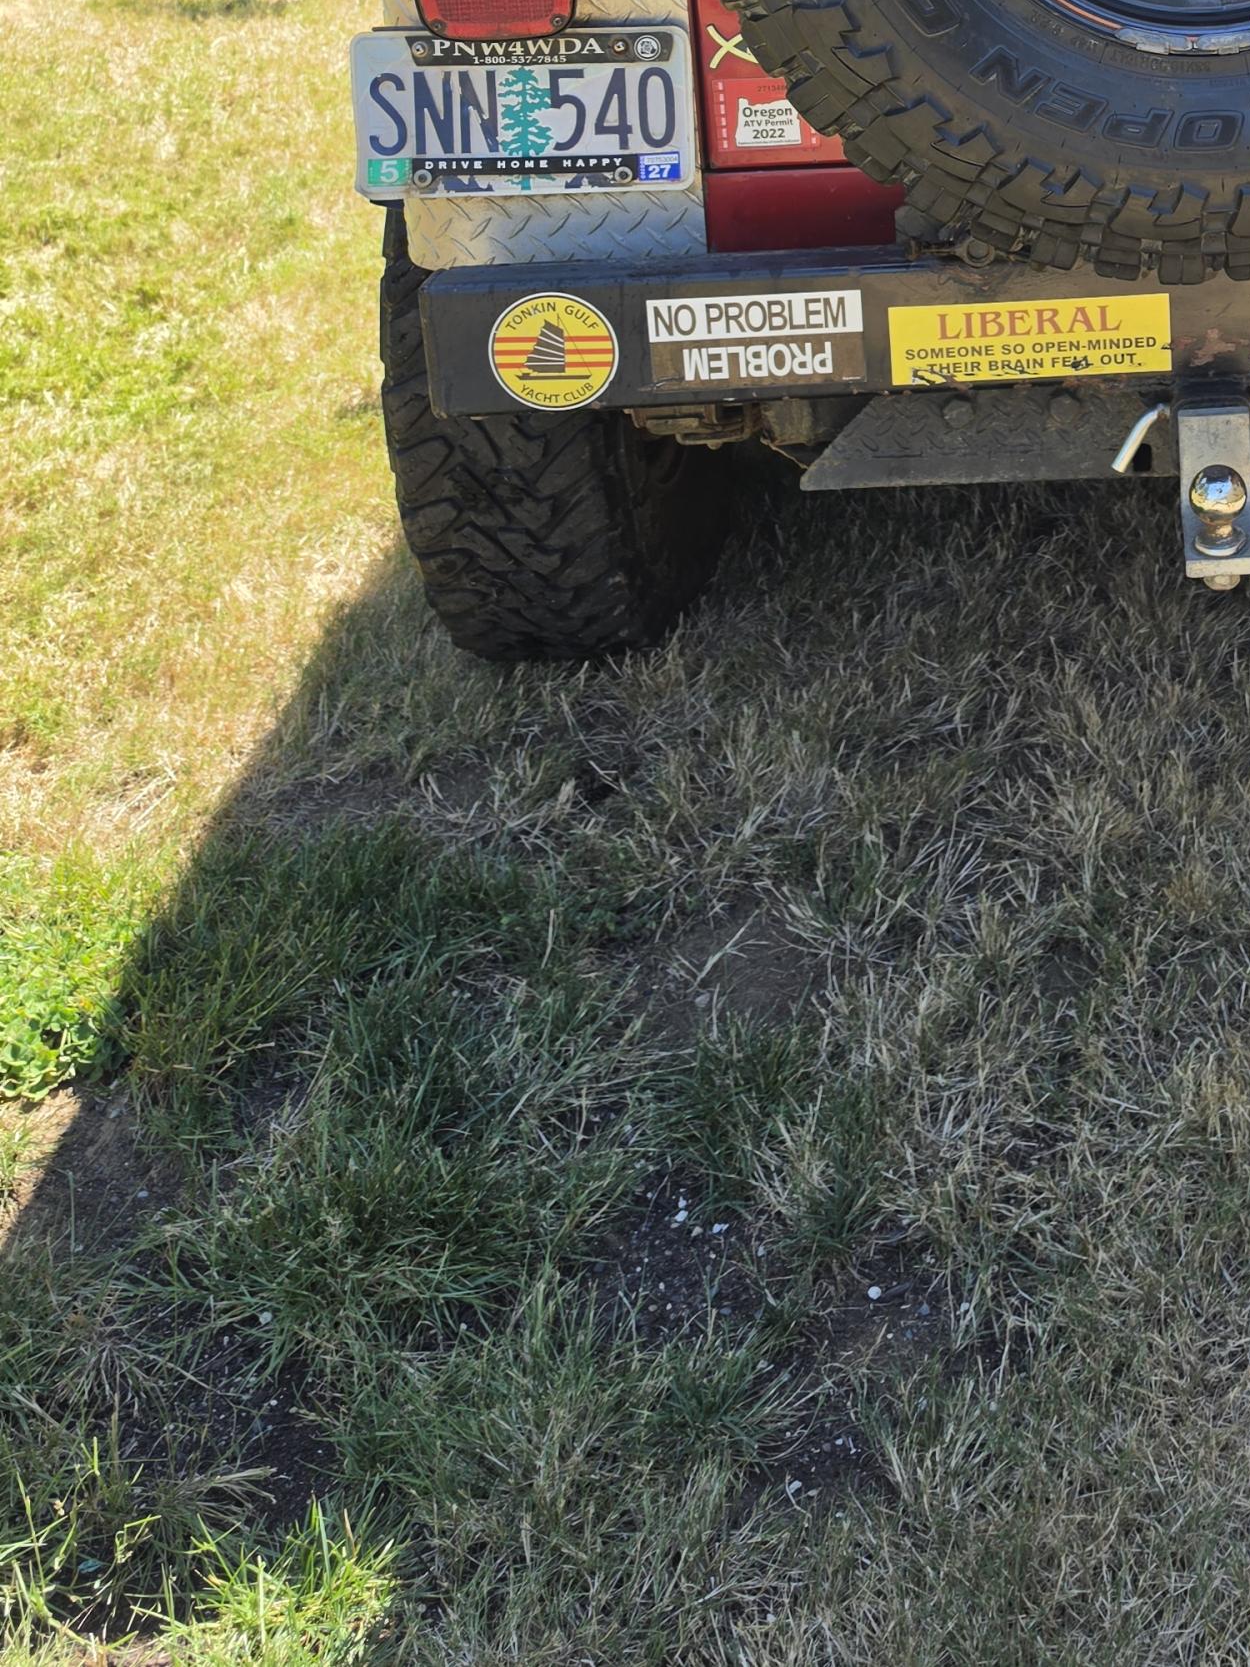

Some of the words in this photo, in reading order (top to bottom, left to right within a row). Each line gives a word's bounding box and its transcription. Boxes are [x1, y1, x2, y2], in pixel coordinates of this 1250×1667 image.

[432, 37, 605, 57] PNW4WDA
[472, 55, 567, 65] 1-800-537-7845
[969, 45, 1246, 153] OPEN
[369, 67, 500, 157] SNN
[549, 67, 677, 151] 540
[743, 107, 793, 119] Oregon
[765, 118, 793, 126] Permit
[752, 128, 786, 139] 2022
[380, 160, 399, 183] 5
[425, 160, 483, 170] DRIVE
[496, 159, 549, 169] HOME
[563, 157, 623, 168] HAPPY
[648, 164, 671, 178] 27
[505, 301, 557, 331] TONKIN
[564, 305, 599, 331] GULF
[653, 304, 697, 337] NO
[705, 296, 847, 334] PROBLEM
[937, 305, 1122, 340] LIBERAL
[905, 344, 995, 360] SOMEONE
[1001, 343, 1026, 356] SO
[1031, 336, 1157, 354] OPEN-MINDED
[682, 341, 834, 381] PROBLEM
[926, 361, 982, 375] THEIR
[988, 357, 1044, 372] BRAIN
[520, 384, 560, 403] YACHT
[563, 382, 594, 401] CLUB
